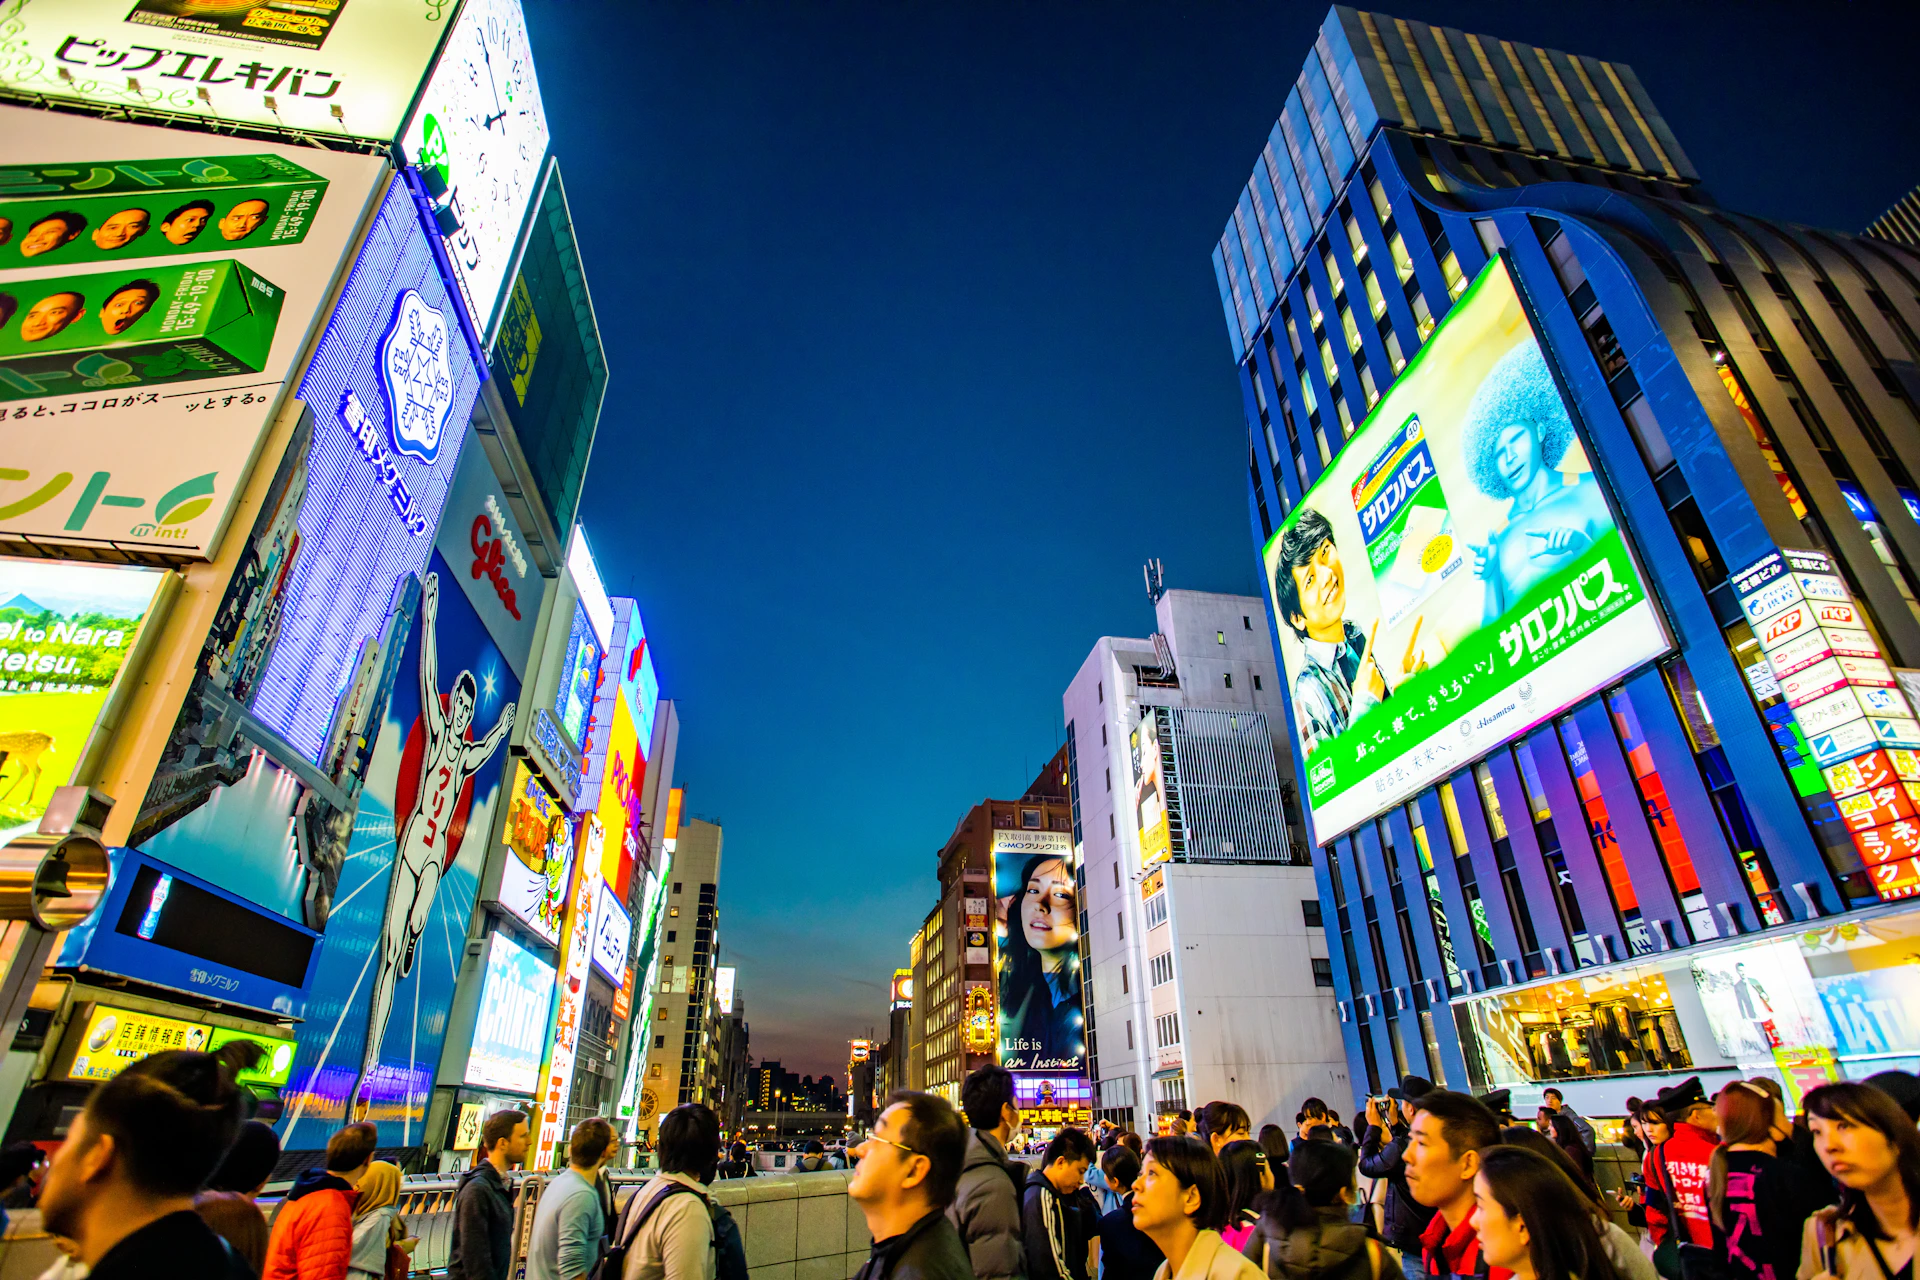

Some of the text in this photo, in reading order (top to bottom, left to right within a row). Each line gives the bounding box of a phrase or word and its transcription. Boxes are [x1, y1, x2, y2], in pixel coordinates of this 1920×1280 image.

[487, 16, 499, 45] 10
[55, 36, 343, 98] ピップエレキバン
[270, 190, 303, 241] MONDAY-FRIDAY
[282, 189, 317, 240] 15:49-19:00
[174, 268, 216, 331] 15:49-19:00
[251, 276, 274, 298] MBS
[159, 271, 197, 333] MONDAY-FRIDAY
[1406, 420, 1419, 438] 40
[340, 389, 428, 537] 雪印メグミルク
[1363, 451, 1431, 534] サロンパス
[471, 514, 522, 622] Glico
[1498, 557, 1626, 667] サロンパス
[1768, 612, 1800, 640] TKP
[1822, 607, 1851, 621] TKP
[25, 627, 46, 643] to
[49, 621, 125, 648] Nara
[1476, 702, 1517, 731] Hisamitsu
[423, 764, 454, 849] グリコ
[997, 832, 1032, 842] FX取引高
[998, 841, 1067, 851] GMOクリック証券
[1850, 811, 1899, 883] コミック
[190, 968, 240, 992] 雪印メグミルク
[1005, 1038, 1042, 1051] Life is
[1004, 1056, 1027, 1069] an
